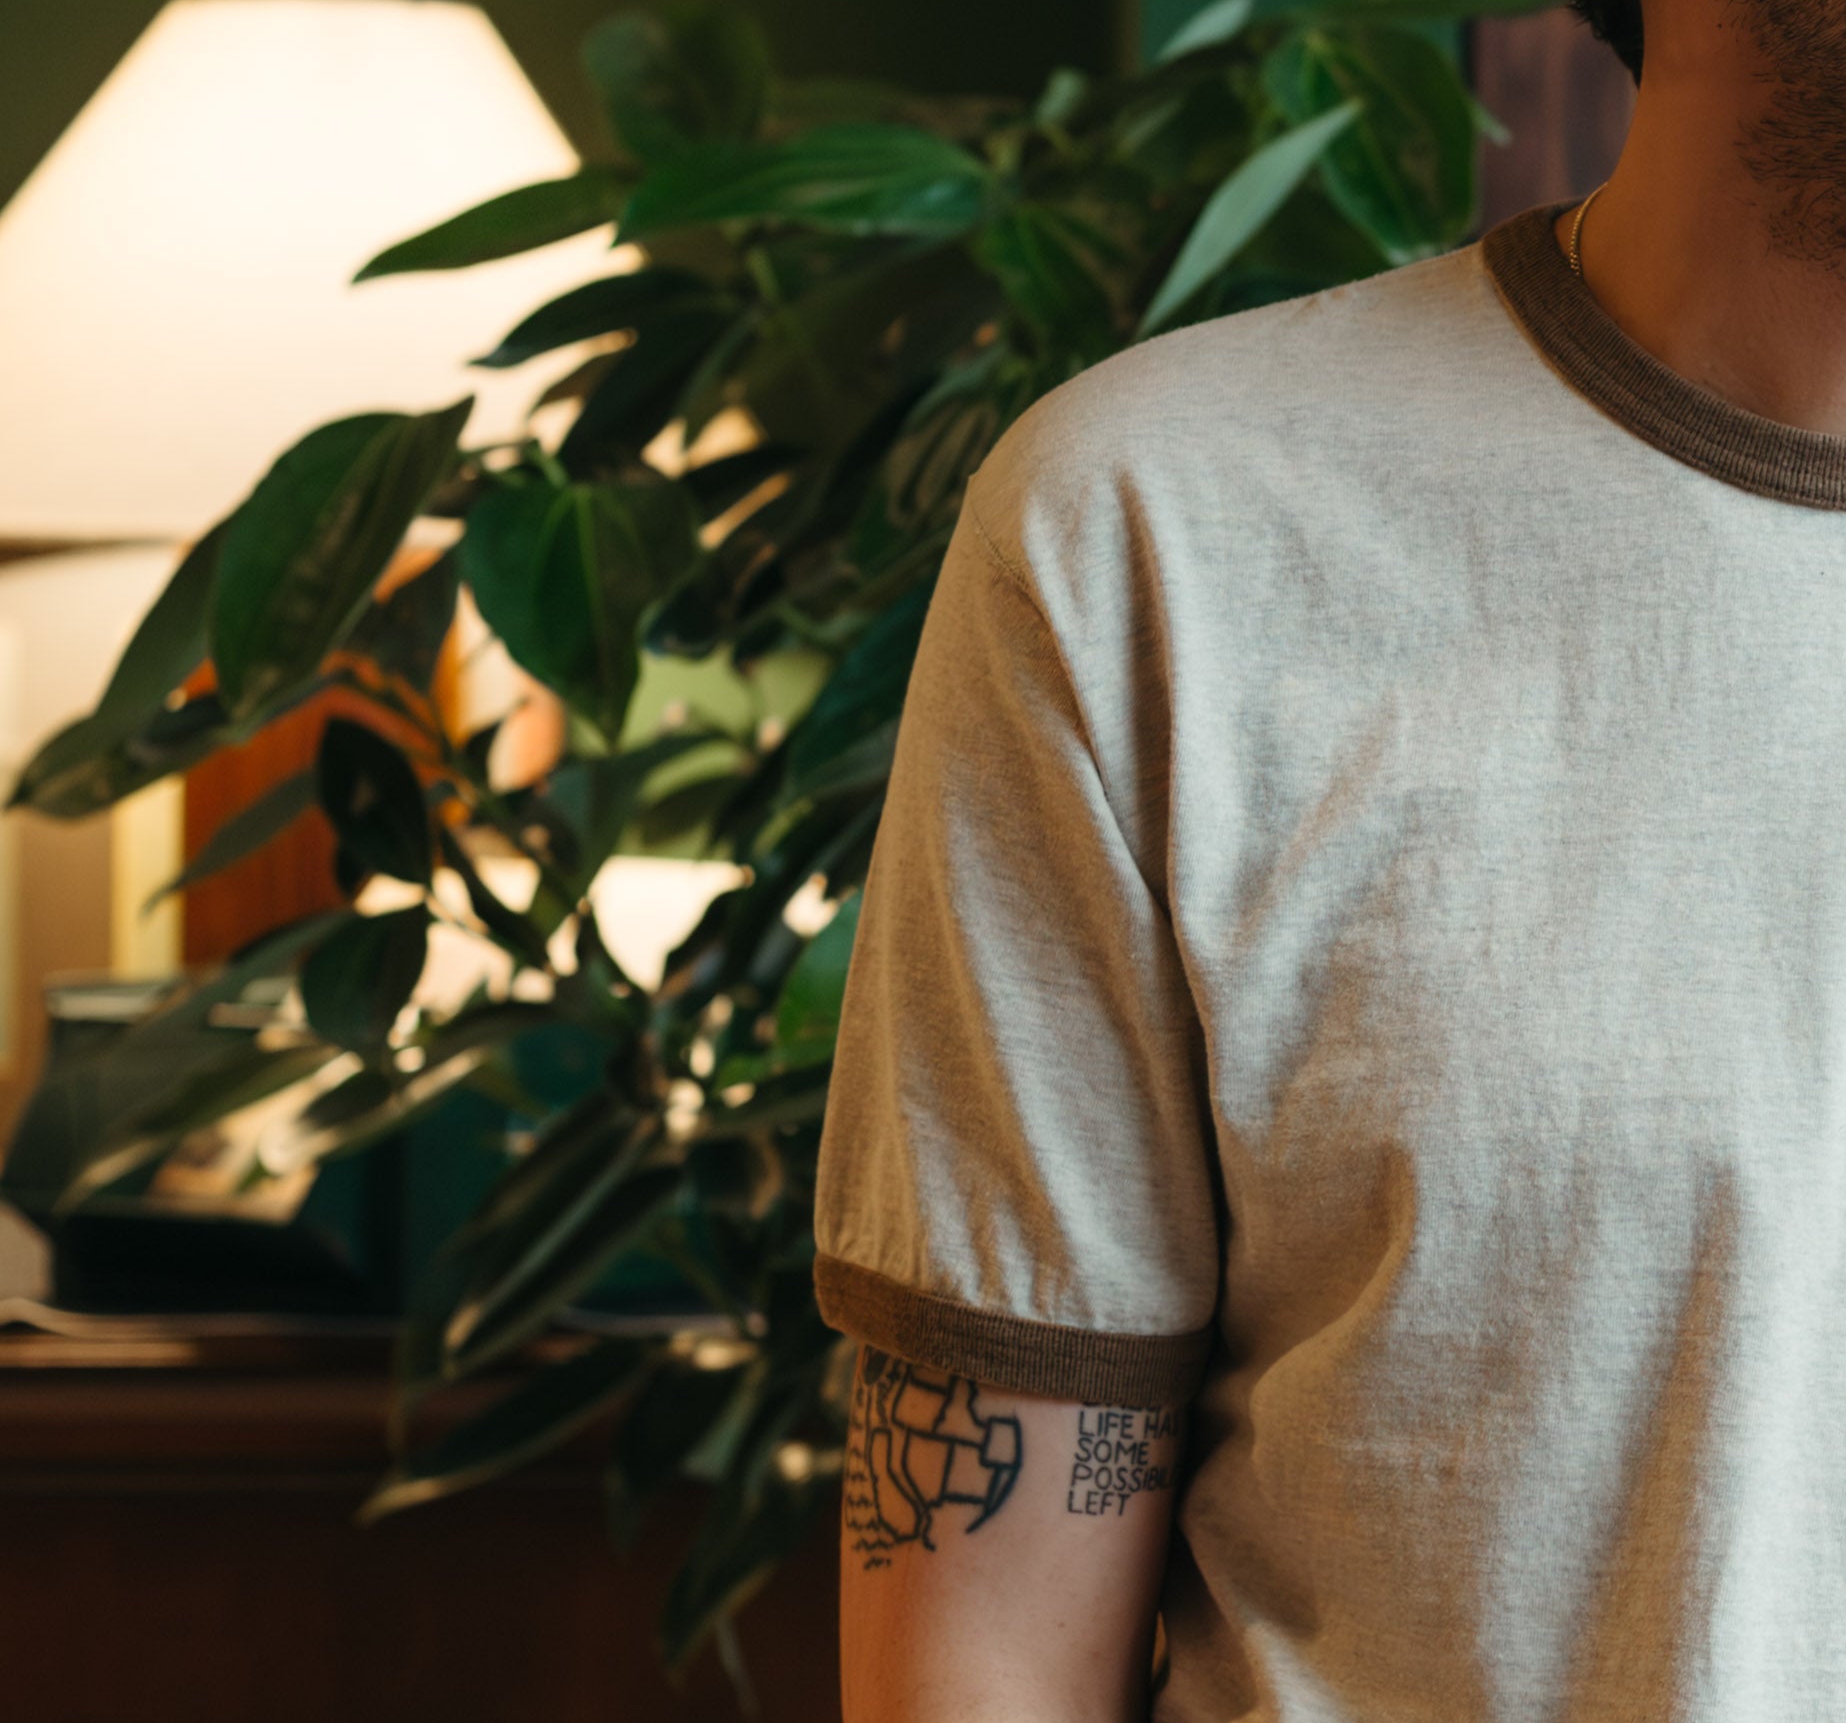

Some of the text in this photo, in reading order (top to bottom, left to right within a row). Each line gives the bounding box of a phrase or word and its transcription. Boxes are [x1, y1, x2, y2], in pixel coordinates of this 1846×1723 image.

[1078, 1410, 1134, 1438] LIFE
[1074, 1437, 1150, 1467] SOME
[1067, 1490, 1132, 1517] LEFT
